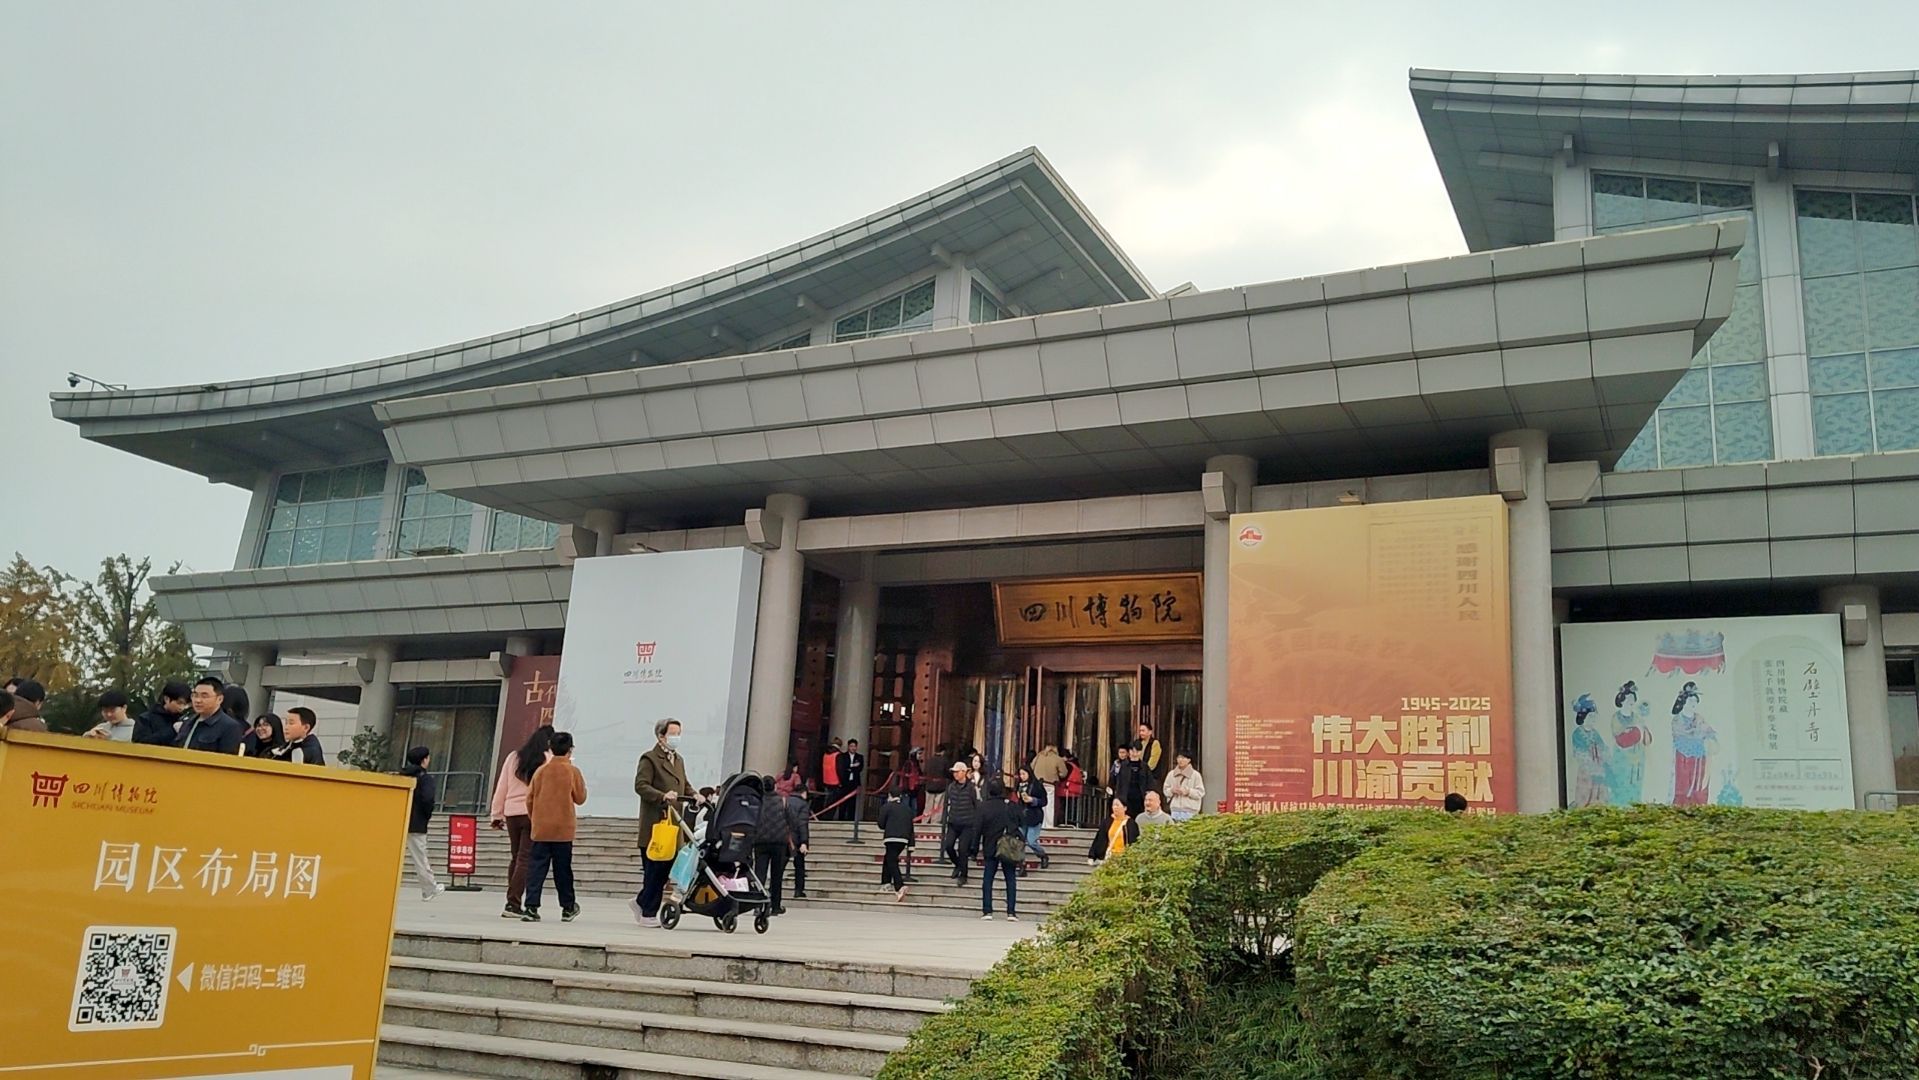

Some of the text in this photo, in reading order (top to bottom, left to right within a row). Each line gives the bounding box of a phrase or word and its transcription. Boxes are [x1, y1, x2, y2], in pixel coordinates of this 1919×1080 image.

[1018, 591, 1182, 629] 四川博物院
[1401, 697, 1491, 711] 1945-2025
[1802, 661, 1821, 742] 石壁丹青
[1311, 715, 1491, 755] 伟大胜利
[72, 781, 158, 804] 四川博物院
[1311, 758, 1494, 802] 川渝贡献
[71, 801, 156, 815] SICHUAN MUSEUM
[94, 840, 322, 900] 园区布局图
[200, 964, 306, 992] 微信扫码二维码
